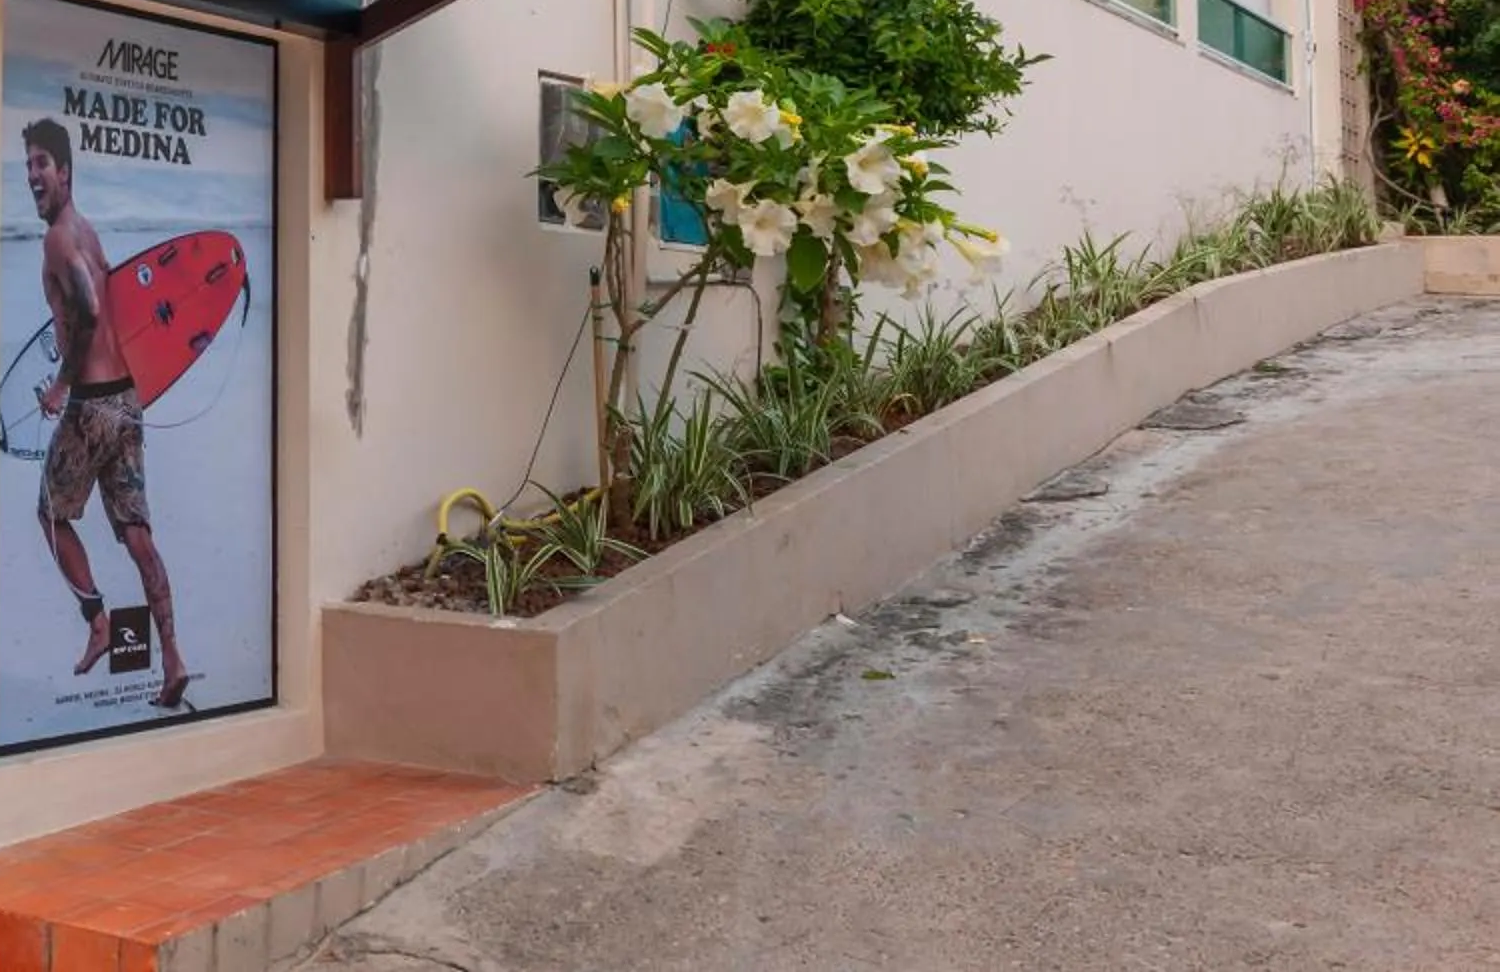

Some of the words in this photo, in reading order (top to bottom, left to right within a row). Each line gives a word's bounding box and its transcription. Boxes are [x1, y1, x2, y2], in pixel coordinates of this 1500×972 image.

[97, 38, 179, 82] MIRAGE
[63, 86, 148, 127] MADE
[155, 101, 207, 137] FOR
[79, 123, 192, 165] MEDINA
